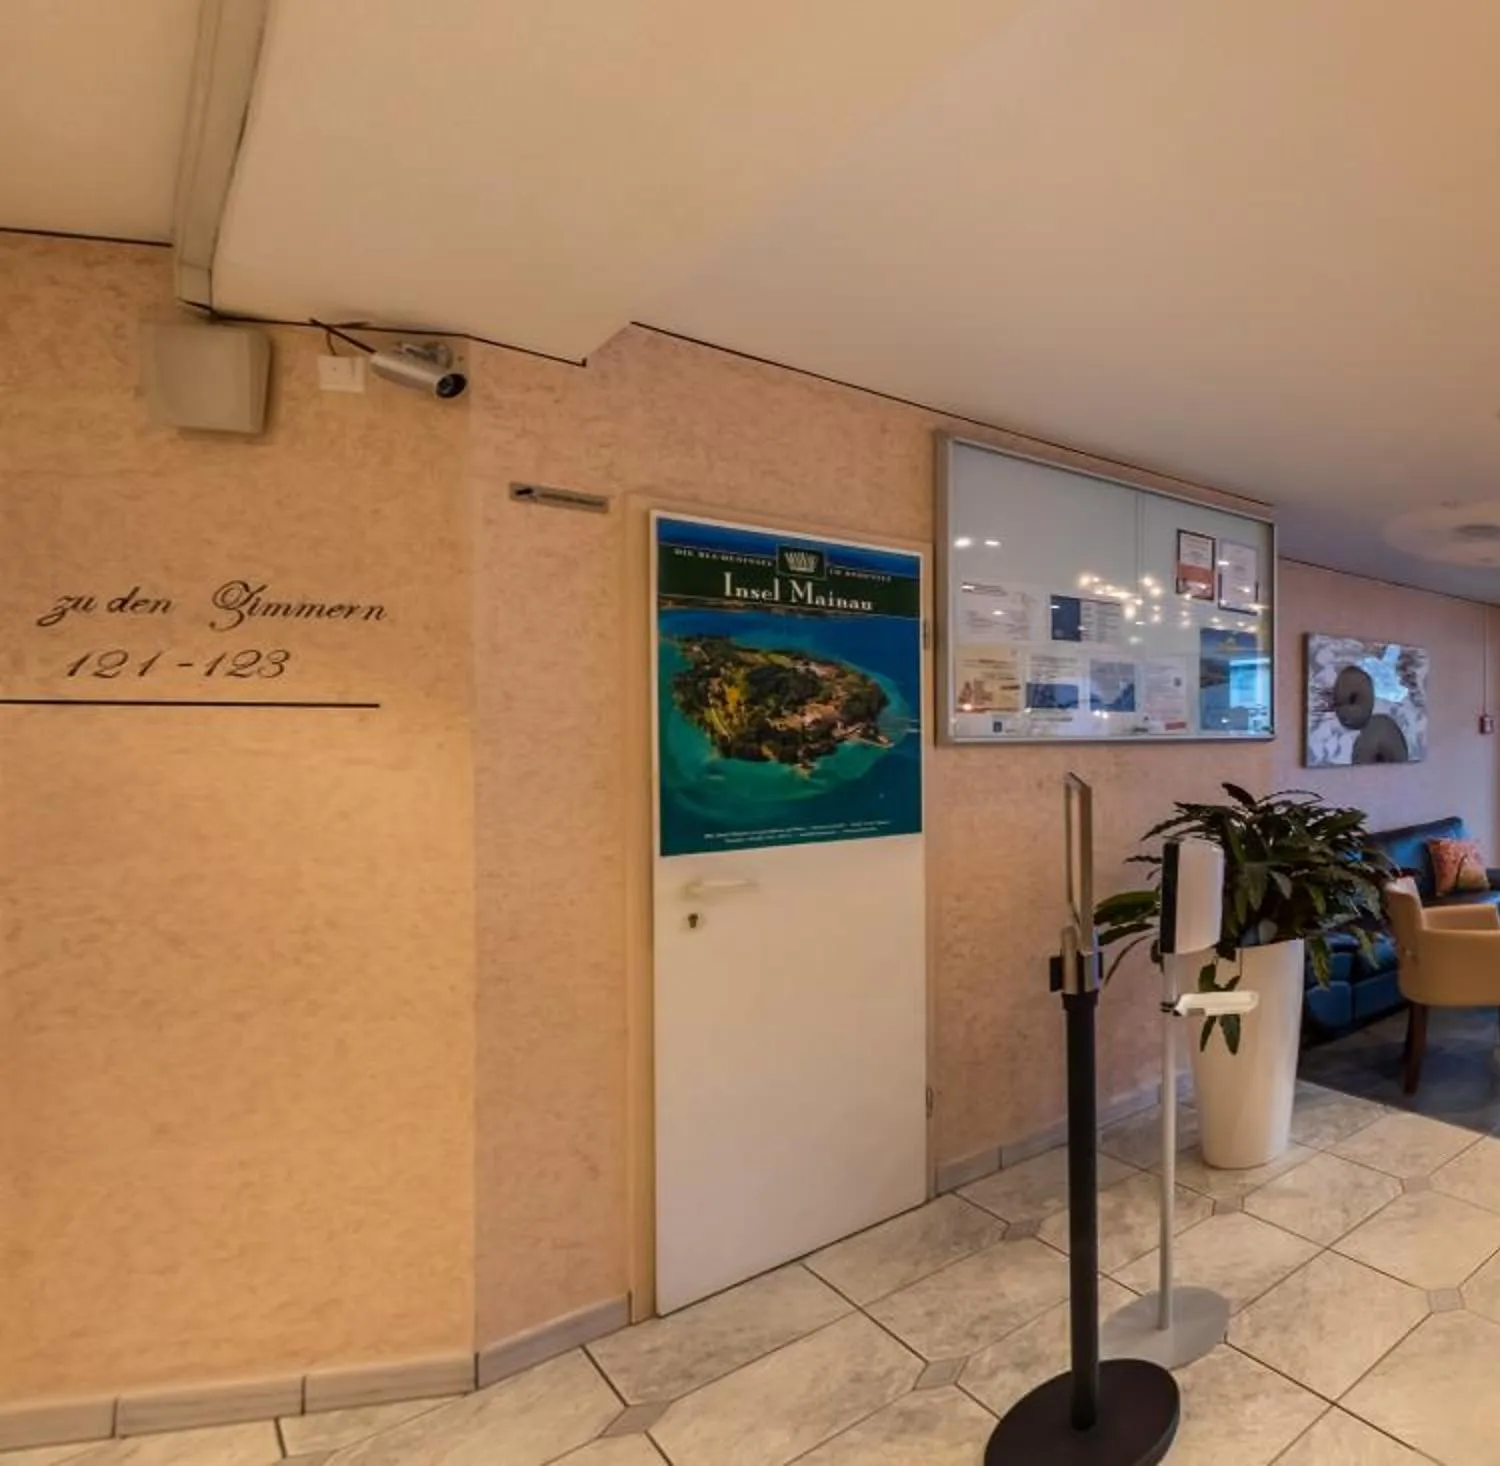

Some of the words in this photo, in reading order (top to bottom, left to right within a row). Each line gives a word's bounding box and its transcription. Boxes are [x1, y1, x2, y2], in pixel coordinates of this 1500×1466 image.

[36, 593, 98, 627] zu
[106, 586, 174, 615] den
[208, 579, 388, 632] Zimmern
[723, 572, 780, 602] Insel
[789, 580, 873, 611] Mainau
[66, 649, 165, 679] 121
[203, 649, 292, 679] 123
